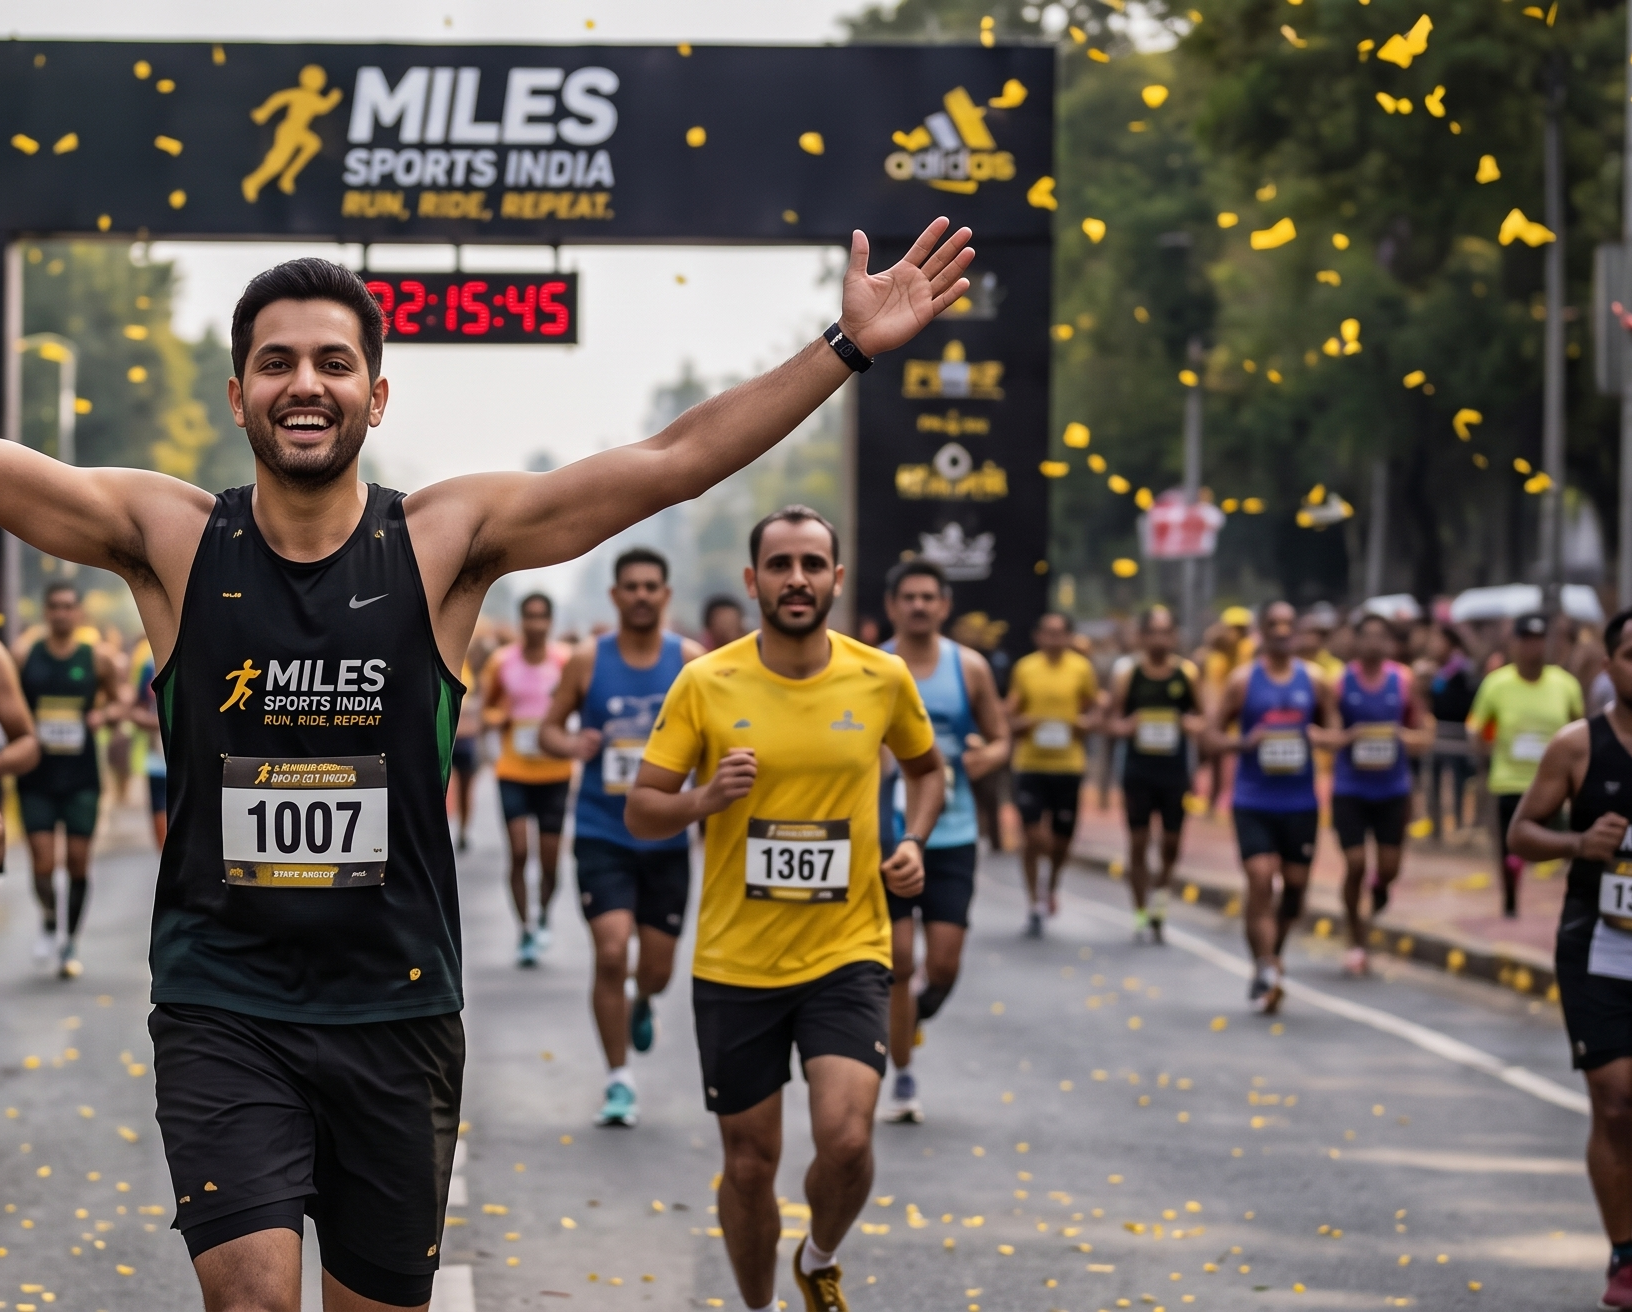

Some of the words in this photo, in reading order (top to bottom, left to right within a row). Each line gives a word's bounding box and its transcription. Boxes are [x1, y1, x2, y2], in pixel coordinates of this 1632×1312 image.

[347, 66, 620, 146] MILES
[342, 148, 498, 187] SPORTS
[504, 149, 615, 188] INDIA
[341, 190, 411, 221] RUN,
[418, 190, 493, 222] RIDE,
[500, 191, 615, 220] REPEAT.
[266, 659, 387, 692] MILES
[264, 696, 331, 711] SPORTS
[336, 696, 383, 711] INDIA
[264, 715, 294, 727] RUN,
[298, 715, 330, 727] RIDE,
[334, 715, 382, 726] REPEAT
[247, 800, 362, 854] 1007
[761, 847, 834, 882] 1367
